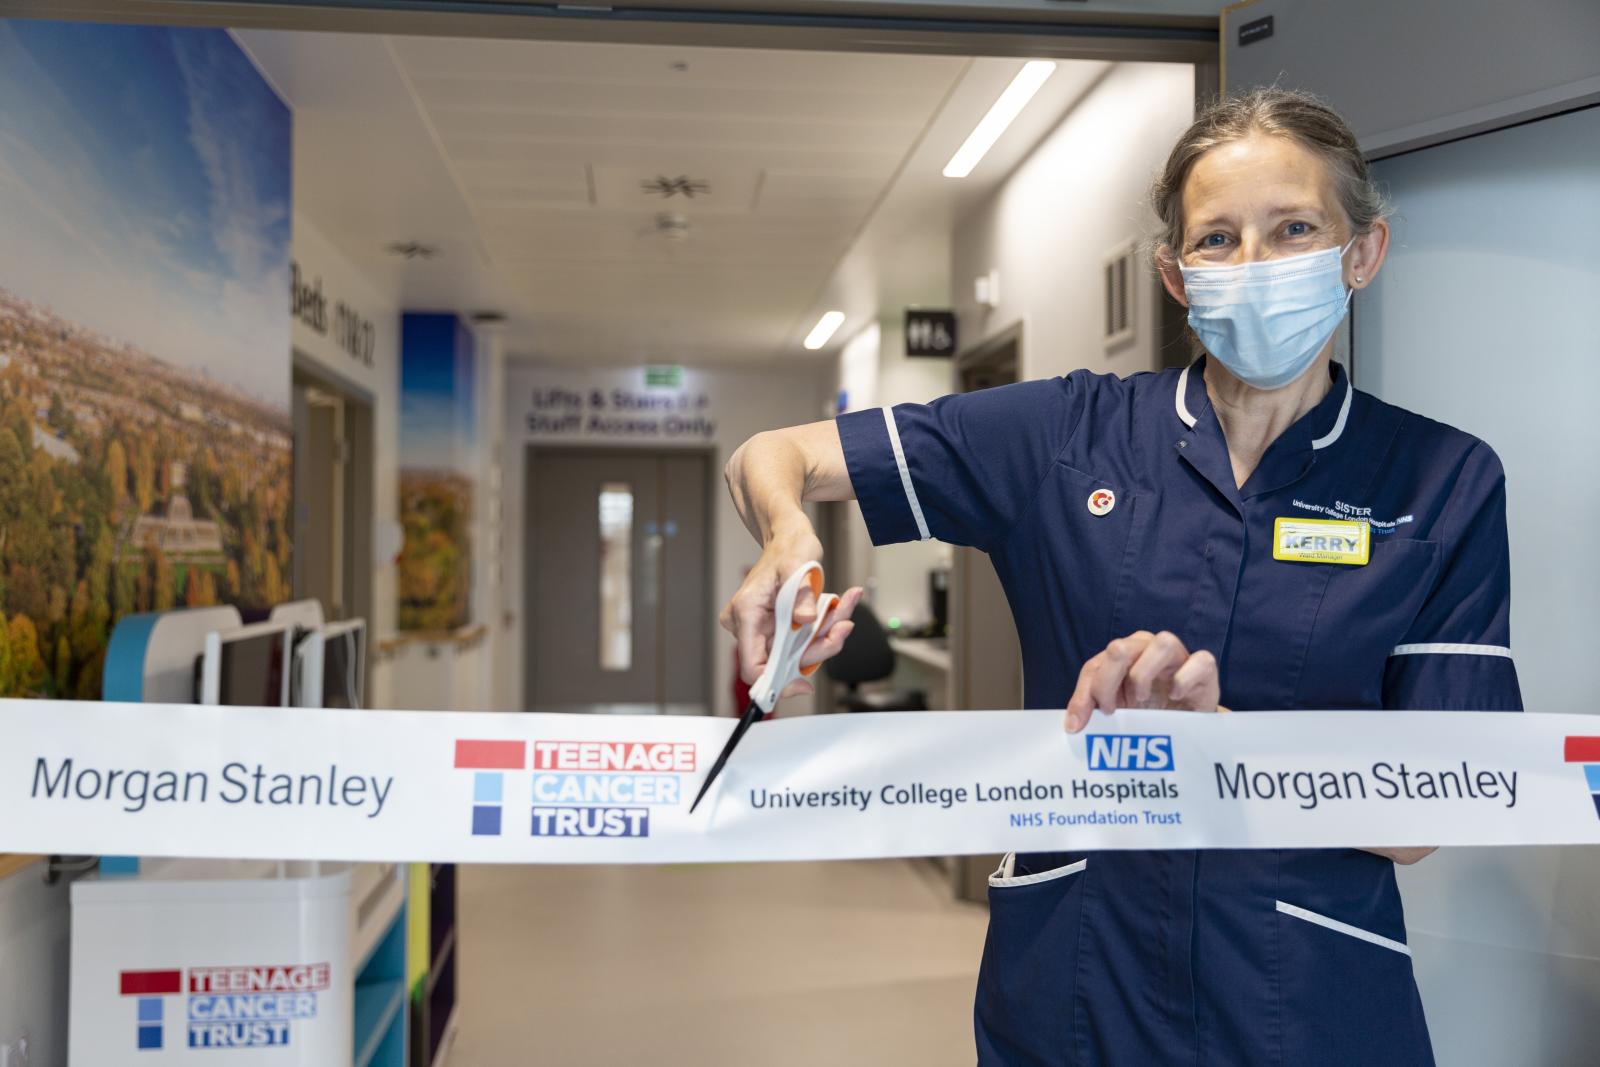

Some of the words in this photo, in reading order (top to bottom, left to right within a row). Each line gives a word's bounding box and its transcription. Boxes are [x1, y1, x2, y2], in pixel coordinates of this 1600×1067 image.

[527, 414, 582, 434] Staff
[587, 414, 658, 434] Access
[661, 416, 717, 438] Only
[1292, 499, 1324, 513] University
[1325, 507, 1344, 520] College
[1335, 500, 1371, 517] SISTER
[1285, 535, 1359, 552] KERRY
[535, 742, 695, 771] TEENAGE
[1089, 736, 1169, 770] NHS
[31, 757, 209, 813] Morgan
[219, 761, 395, 818] Stanley
[534, 774, 678, 803] CANCER
[750, 785, 872, 811] University
[880, 783, 968, 808] College
[976, 780, 1063, 802] London
[1072, 778, 1179, 803] Hospitals
[1214, 762, 1367, 809] Morgan
[1371, 761, 1518, 808] Stanley
[533, 808, 647, 836] TRUST
[1009, 813, 1043, 827] NHS
[1048, 810, 1138, 826] Foundation
[1143, 810, 1182, 825] Trust
[190, 964, 330, 991] TEENAGE
[191, 994, 314, 1018] CANCER
[191, 1020, 287, 1046] TRUST
